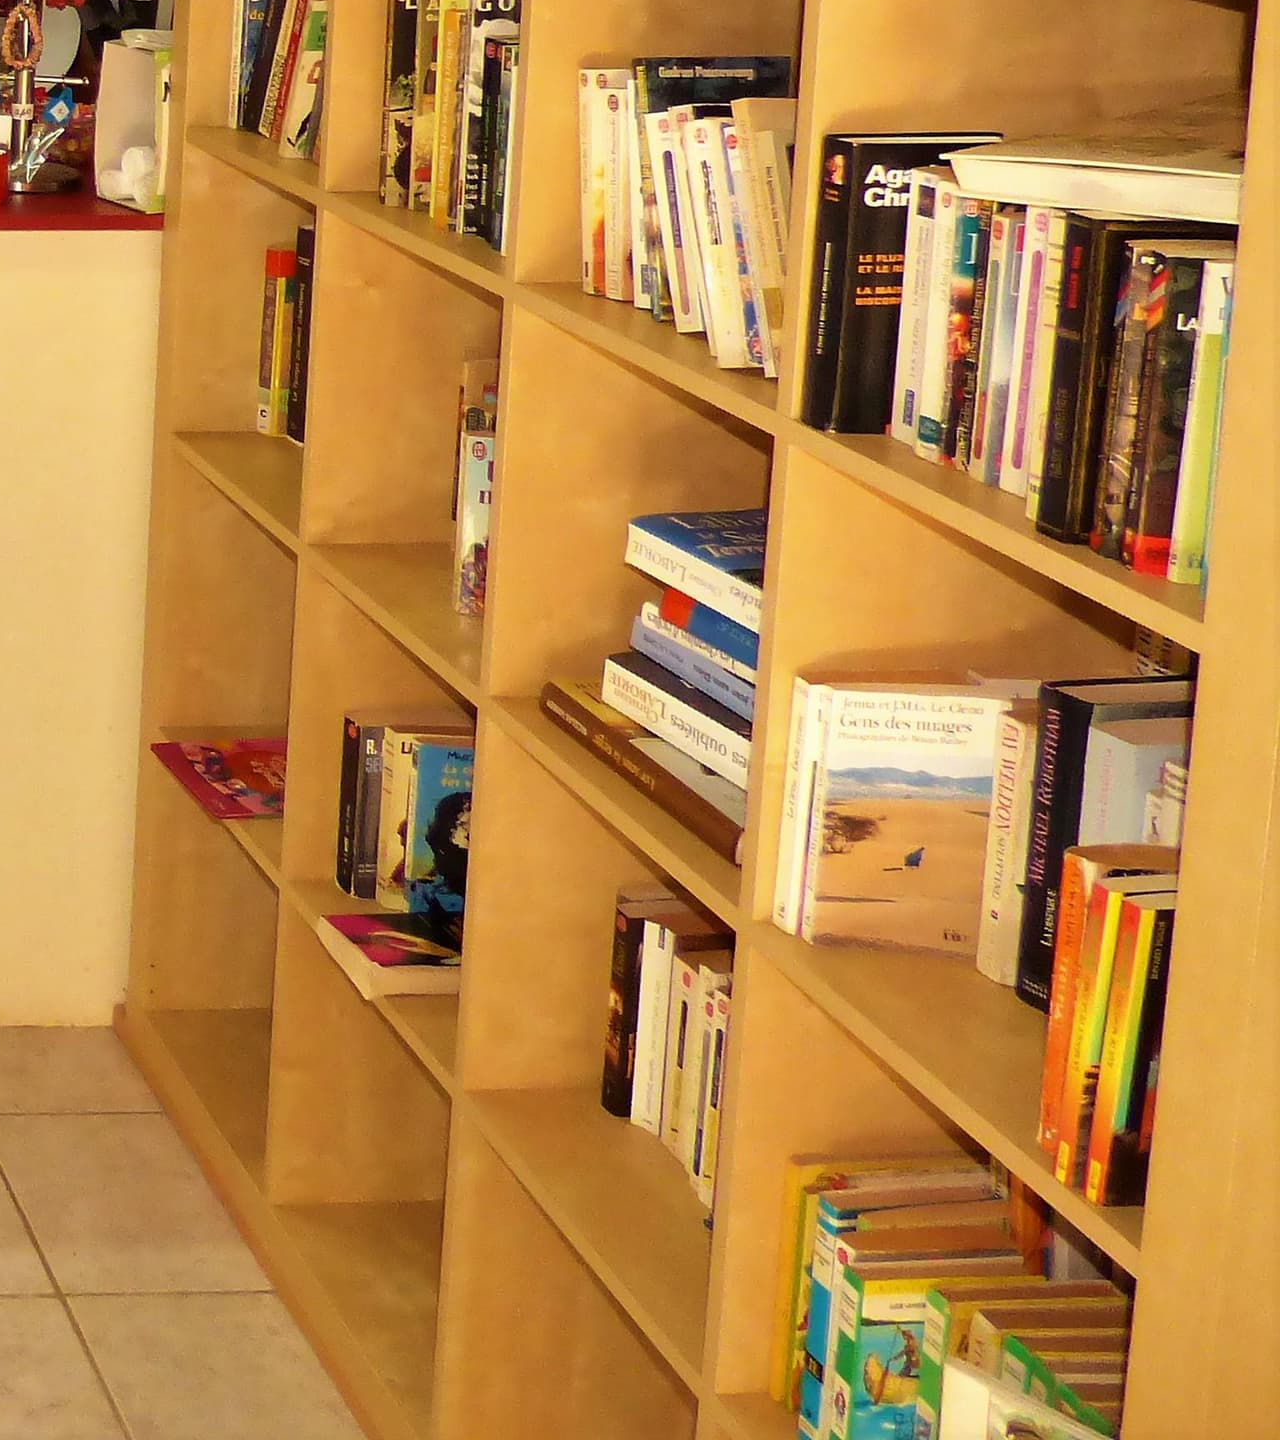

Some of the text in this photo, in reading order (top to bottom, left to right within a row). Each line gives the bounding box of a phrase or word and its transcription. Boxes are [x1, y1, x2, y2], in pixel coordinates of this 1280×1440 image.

[609, 671, 728, 757] LABORIE oubliées
[840, 713, 973, 734] Gens des nuages
[996, 759, 1018, 835] WELDON
[1027, 809, 1051, 886] MICHAEL
